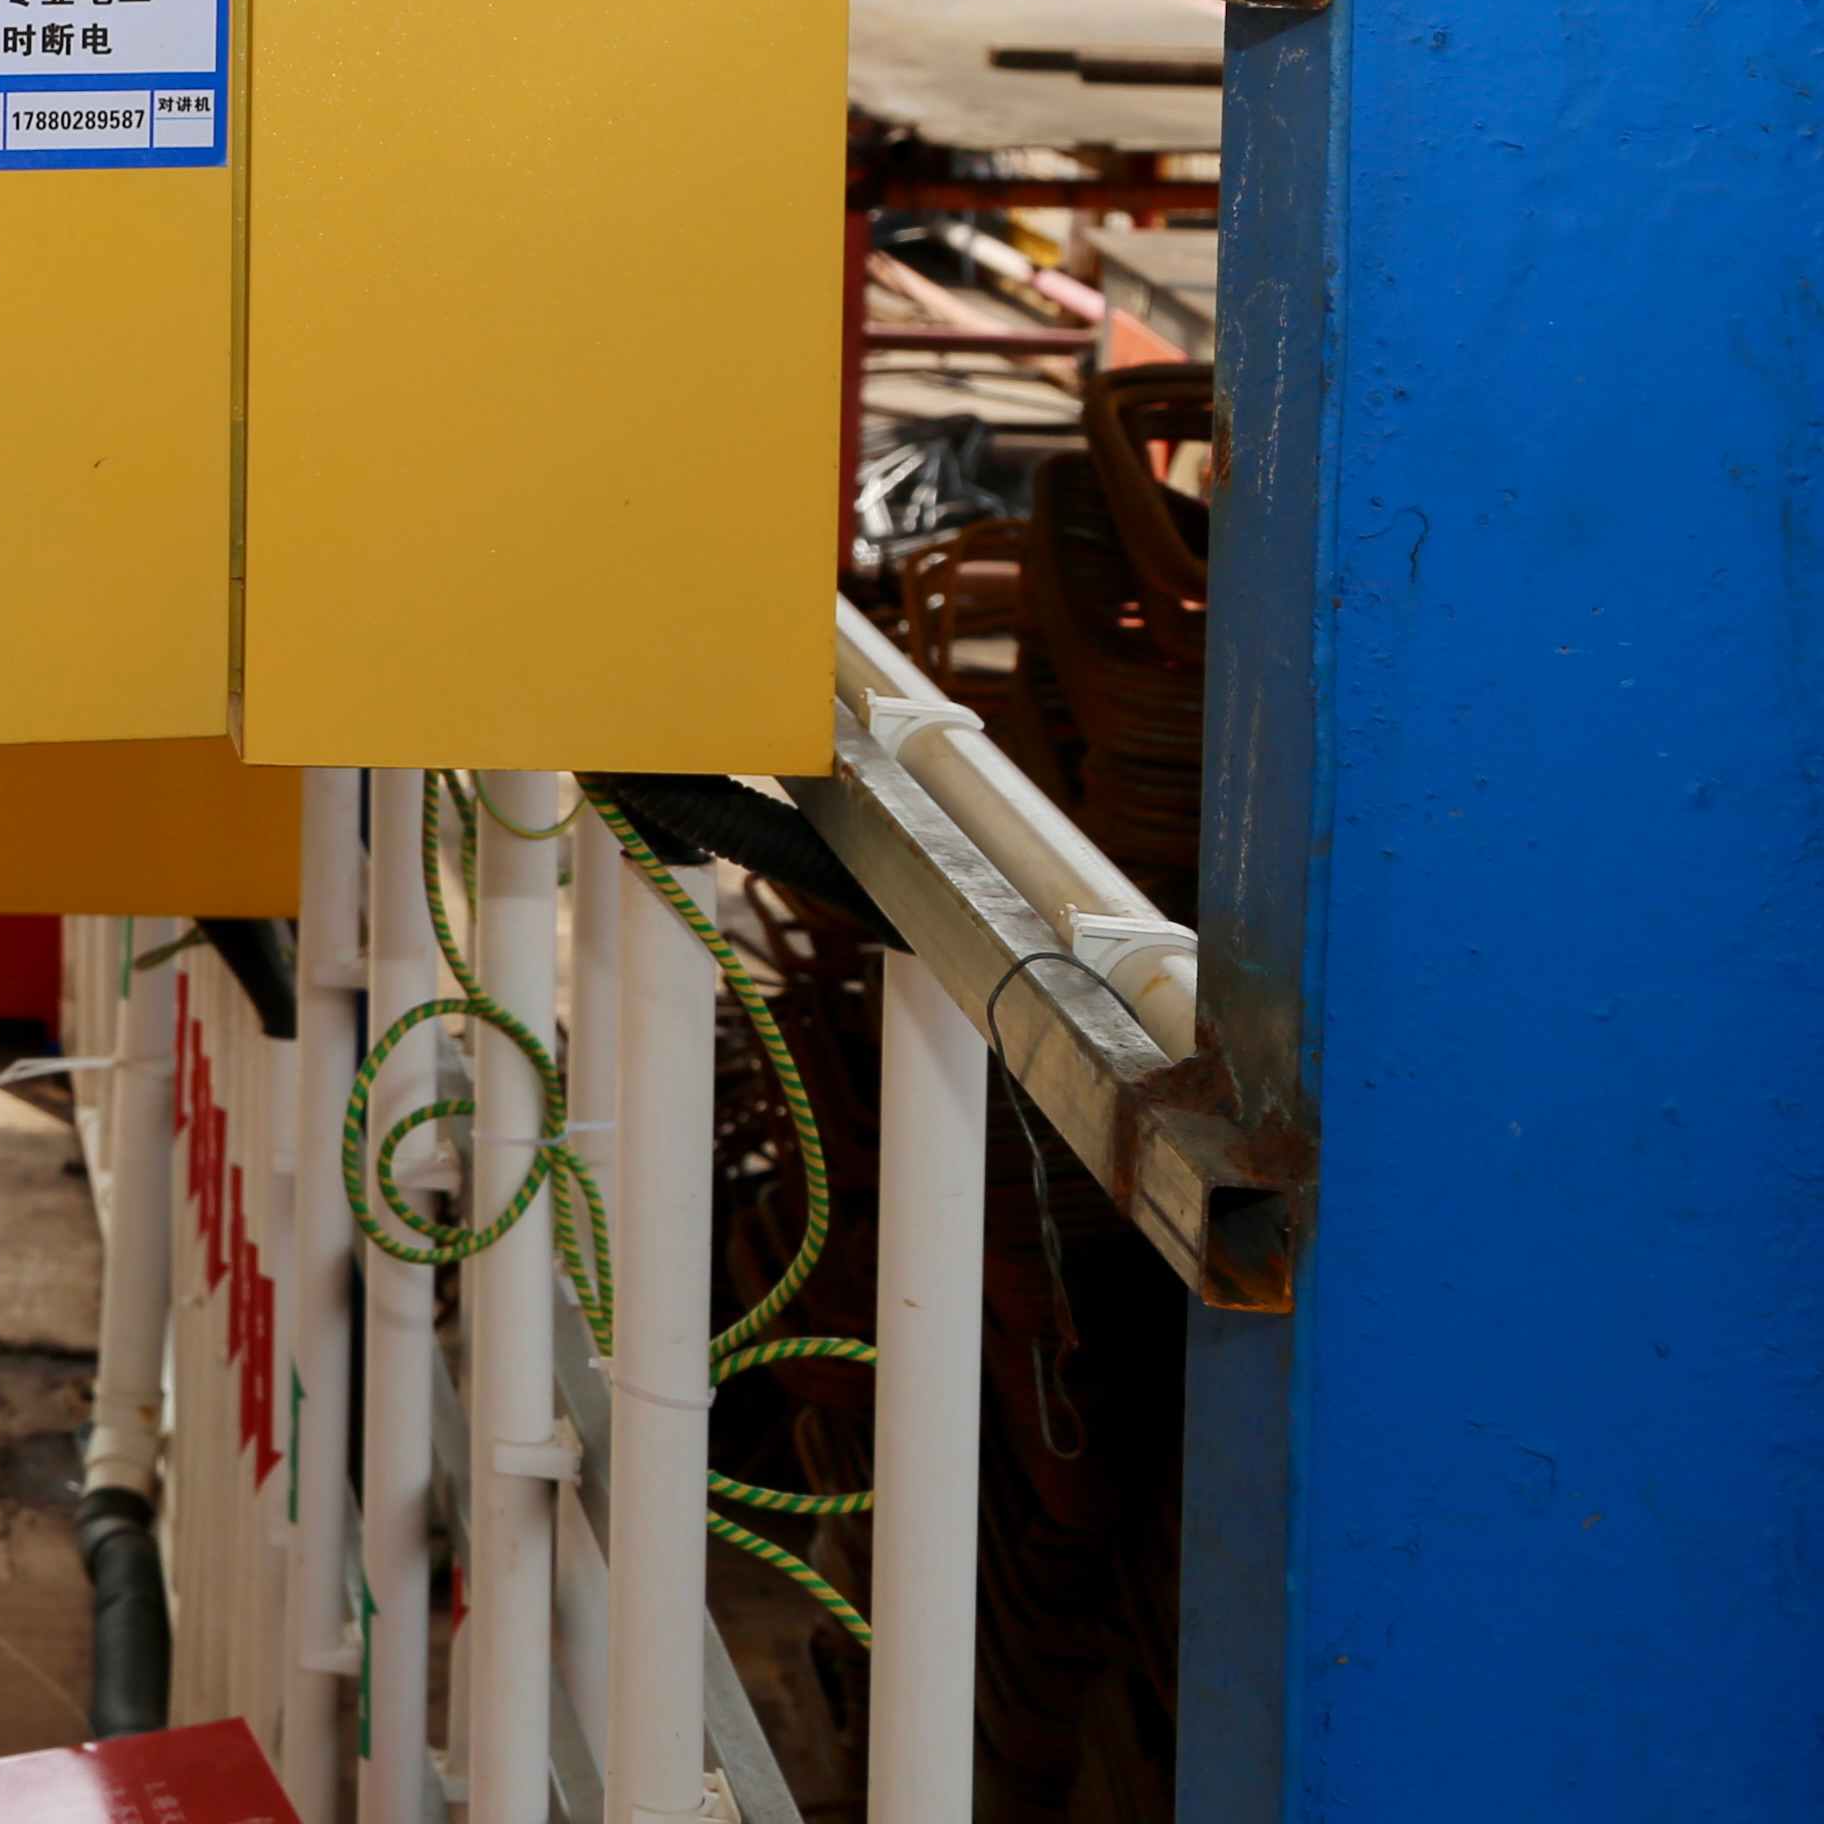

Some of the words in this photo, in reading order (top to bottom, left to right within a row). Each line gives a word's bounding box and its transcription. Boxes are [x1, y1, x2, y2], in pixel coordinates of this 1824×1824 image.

[158, 95, 210, 113] 对讲机
[12, 110, 145, 131] 17880289587
